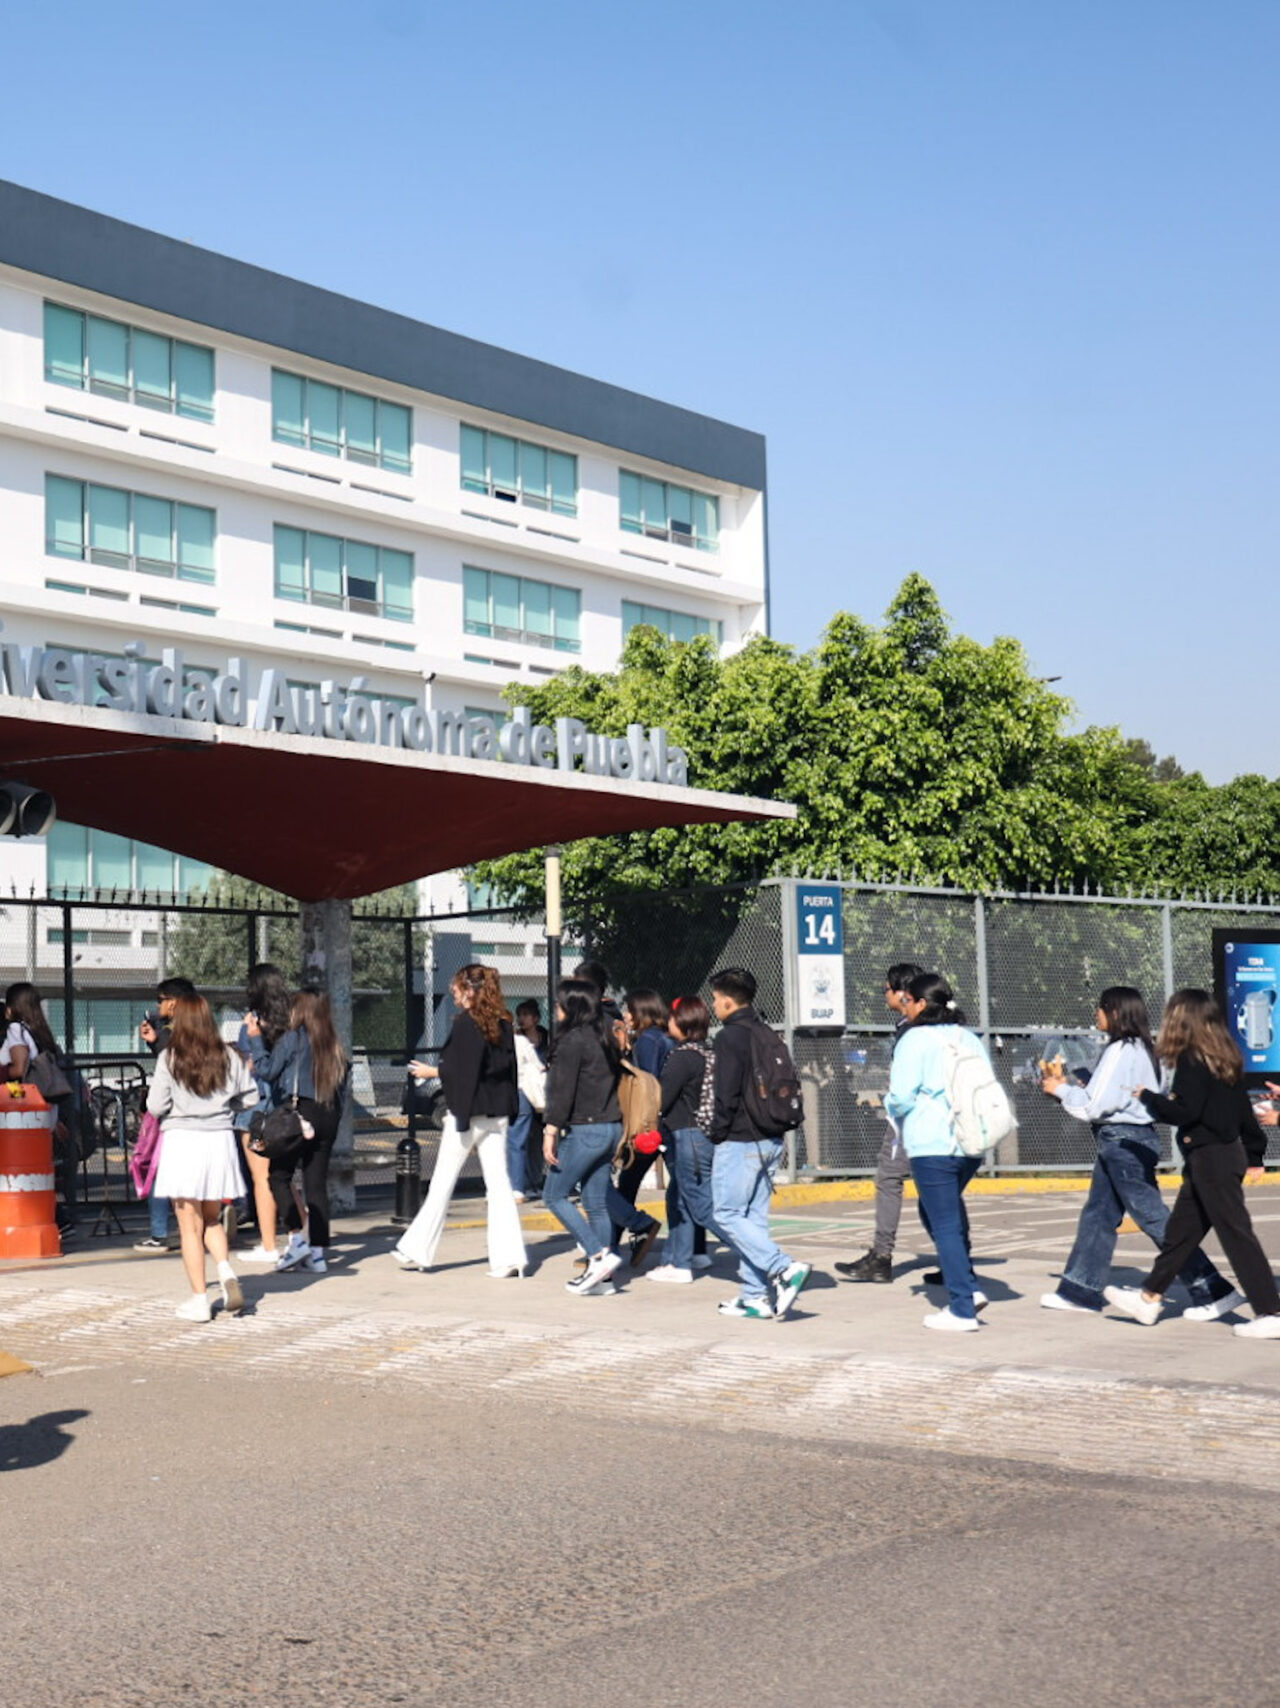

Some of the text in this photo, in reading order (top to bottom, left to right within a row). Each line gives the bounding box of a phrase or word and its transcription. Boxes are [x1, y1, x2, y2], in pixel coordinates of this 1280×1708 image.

[255, 667, 495, 762] Autónoma
[500, 706, 558, 770] de
[556, 717, 688, 788] Puebla
[803, 895, 834, 907] PUERTA
[804, 914, 836, 945] 14
[811, 1008, 834, 1020] BUAP
